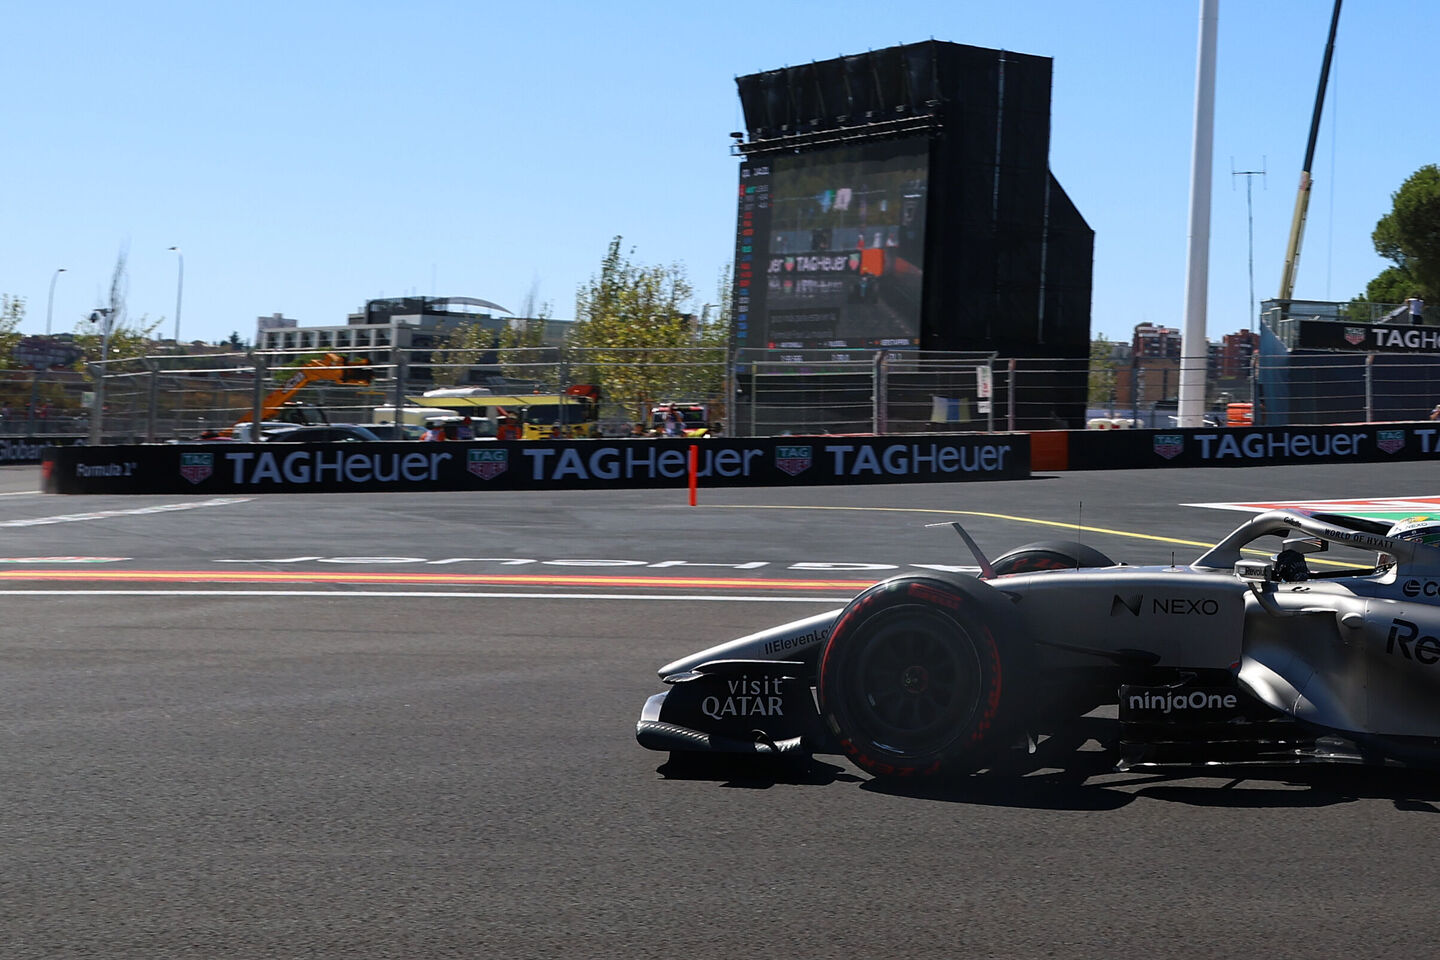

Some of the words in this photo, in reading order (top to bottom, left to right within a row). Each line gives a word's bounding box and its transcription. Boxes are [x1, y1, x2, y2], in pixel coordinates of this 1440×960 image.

[1193, 433, 1367, 459] TAGHeuer
[225, 450, 452, 483] TAGHeuer
[825, 444, 1011, 475] TAGHeuer
[1325, 528, 1350, 541] WORLD
[1353, 534, 1363, 543] OF
[1366, 536, 1394, 549] HYATT
[1152, 598, 1219, 616] NEXO
[727, 675, 783, 695] visit
[702, 696, 784, 721] QATAR
[1129, 691, 1238, 713] ninjaOne
